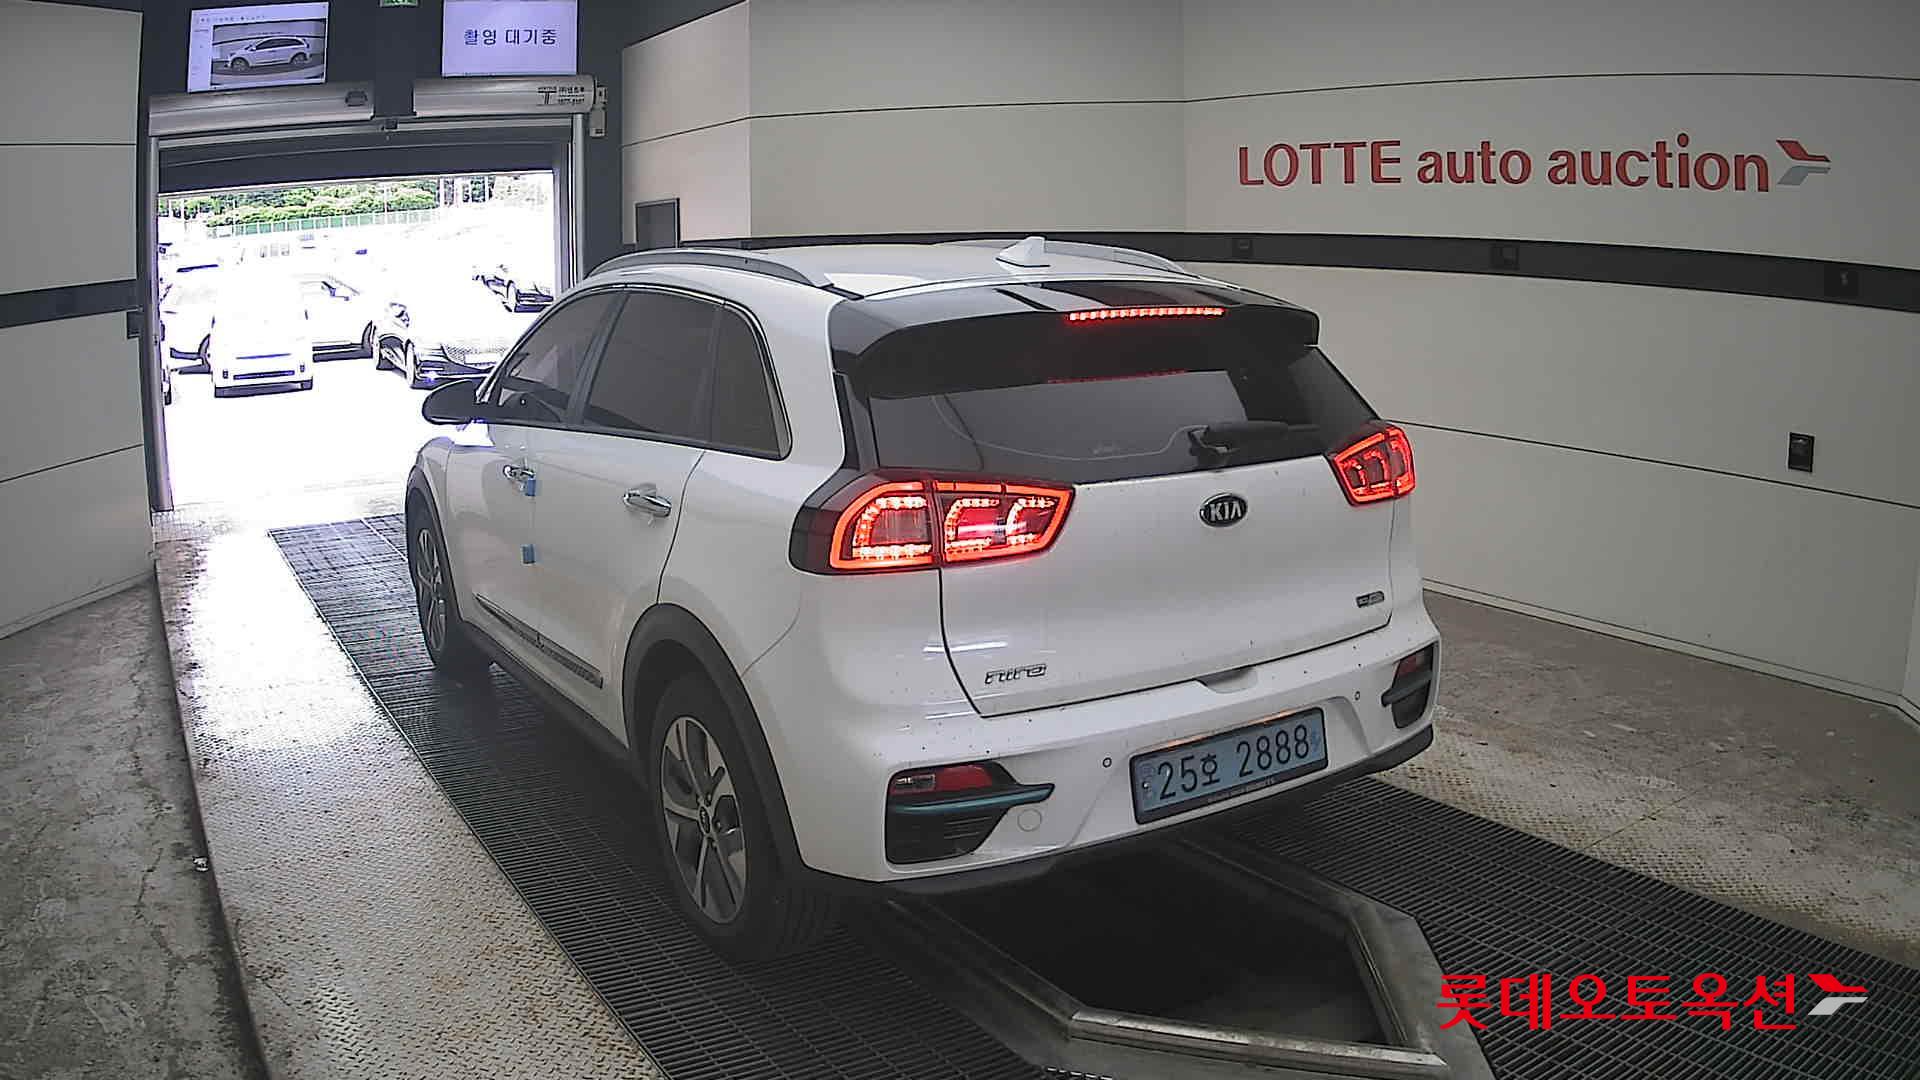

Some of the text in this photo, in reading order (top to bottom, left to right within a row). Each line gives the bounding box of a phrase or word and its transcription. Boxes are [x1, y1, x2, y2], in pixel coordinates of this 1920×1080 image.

[465, 29, 557, 46] 촬영 대기중
[1238, 133, 1769, 192] LOTTE auto auction
[1209, 501, 1242, 522] KIA
[1157, 754, 1221, 801] 25호
[1236, 724, 1310, 779] 2888
